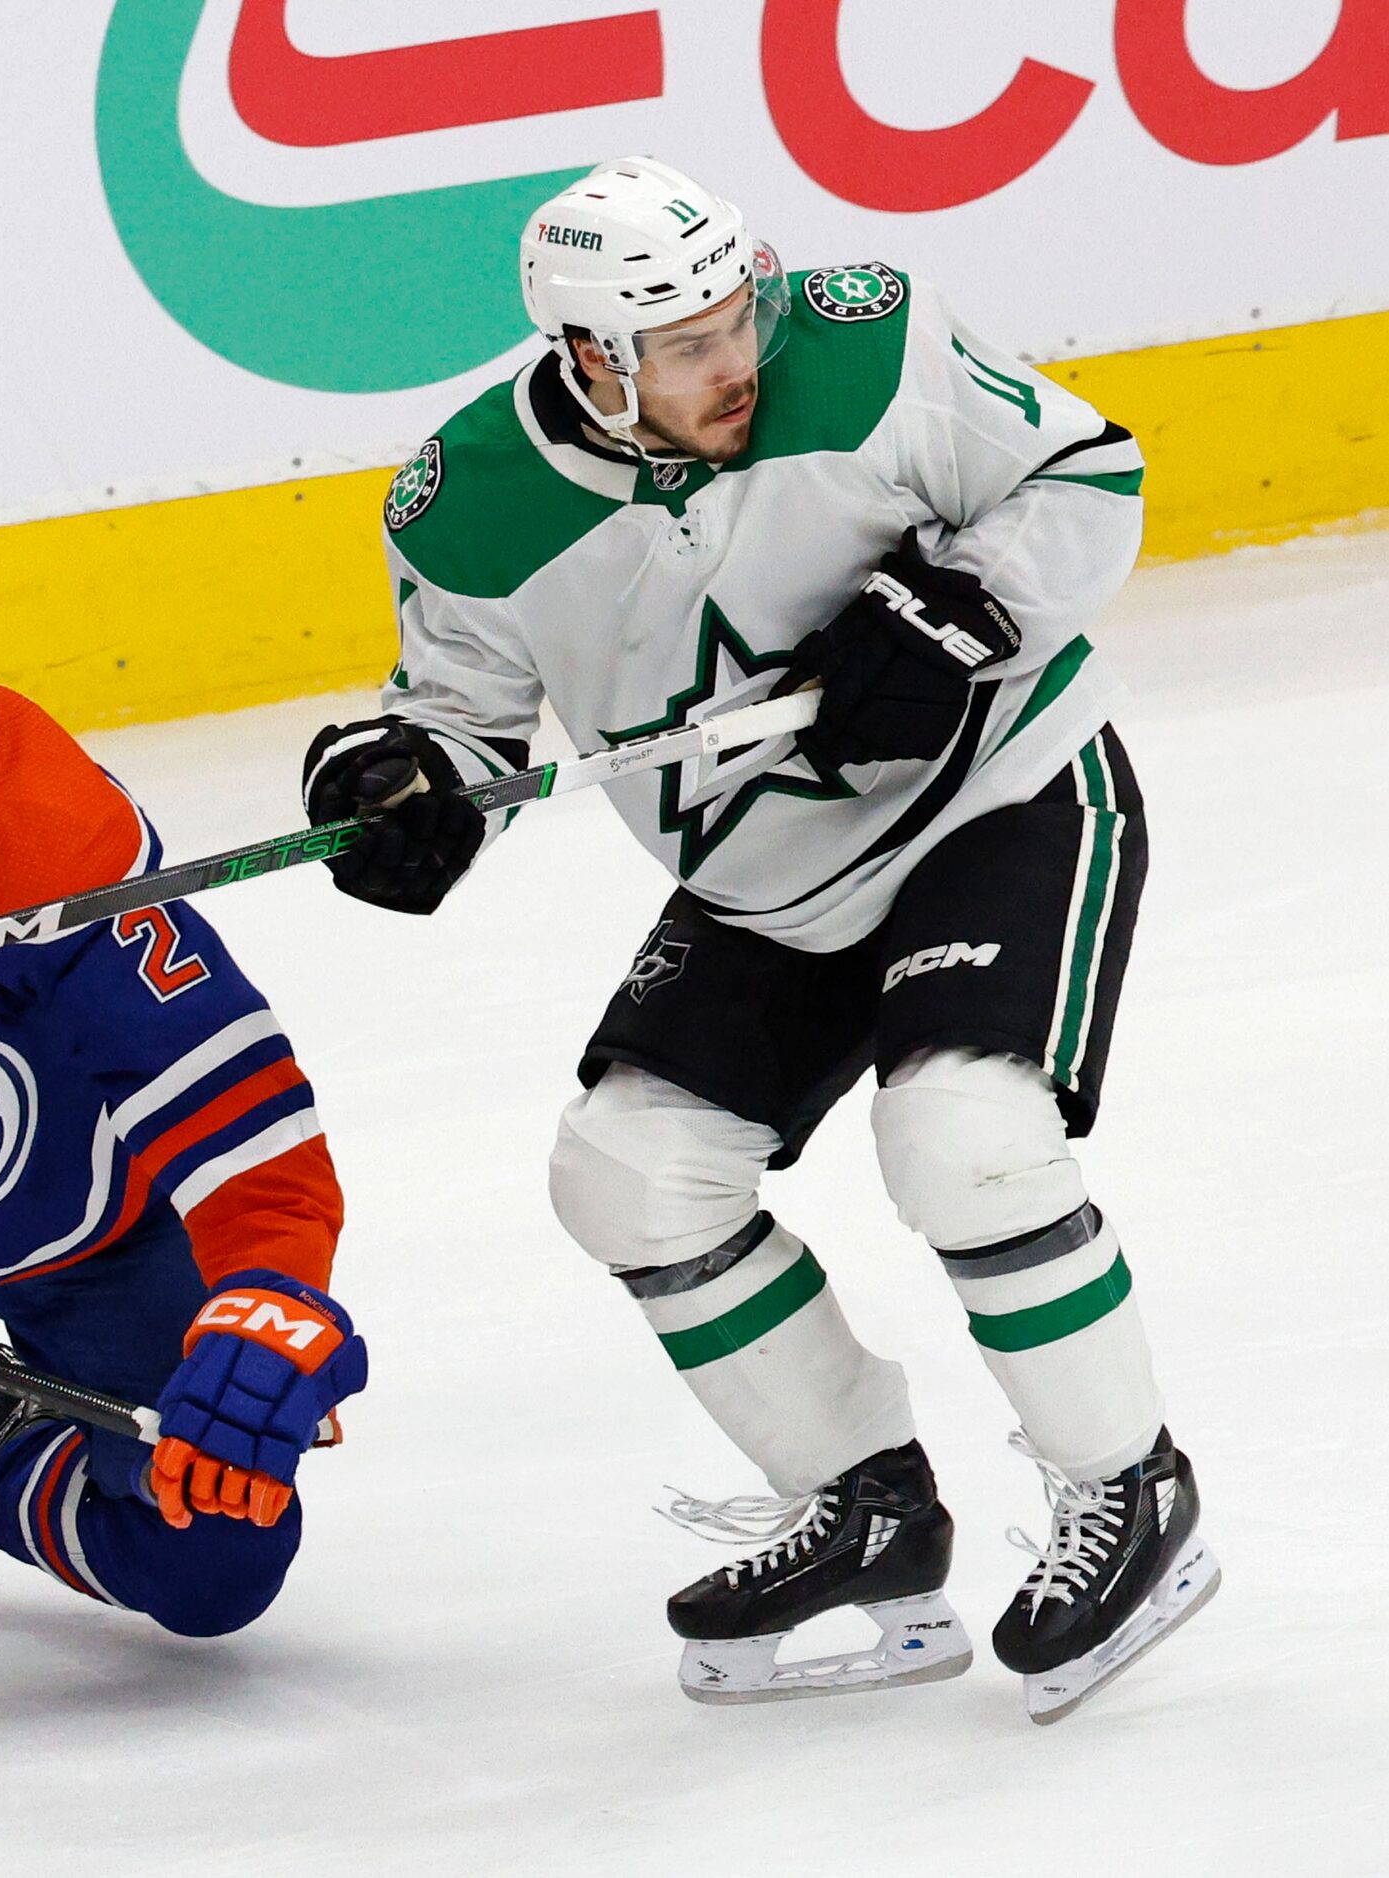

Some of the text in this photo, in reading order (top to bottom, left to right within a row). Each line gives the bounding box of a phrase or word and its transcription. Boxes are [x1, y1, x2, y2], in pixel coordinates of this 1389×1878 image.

[662, 199, 700, 224] 11
[691, 236, 736, 275] CCM
[112, 904, 211, 1004] 2
[883, 942, 1001, 993] CCM
[903, 1619, 955, 1633] TRUE
